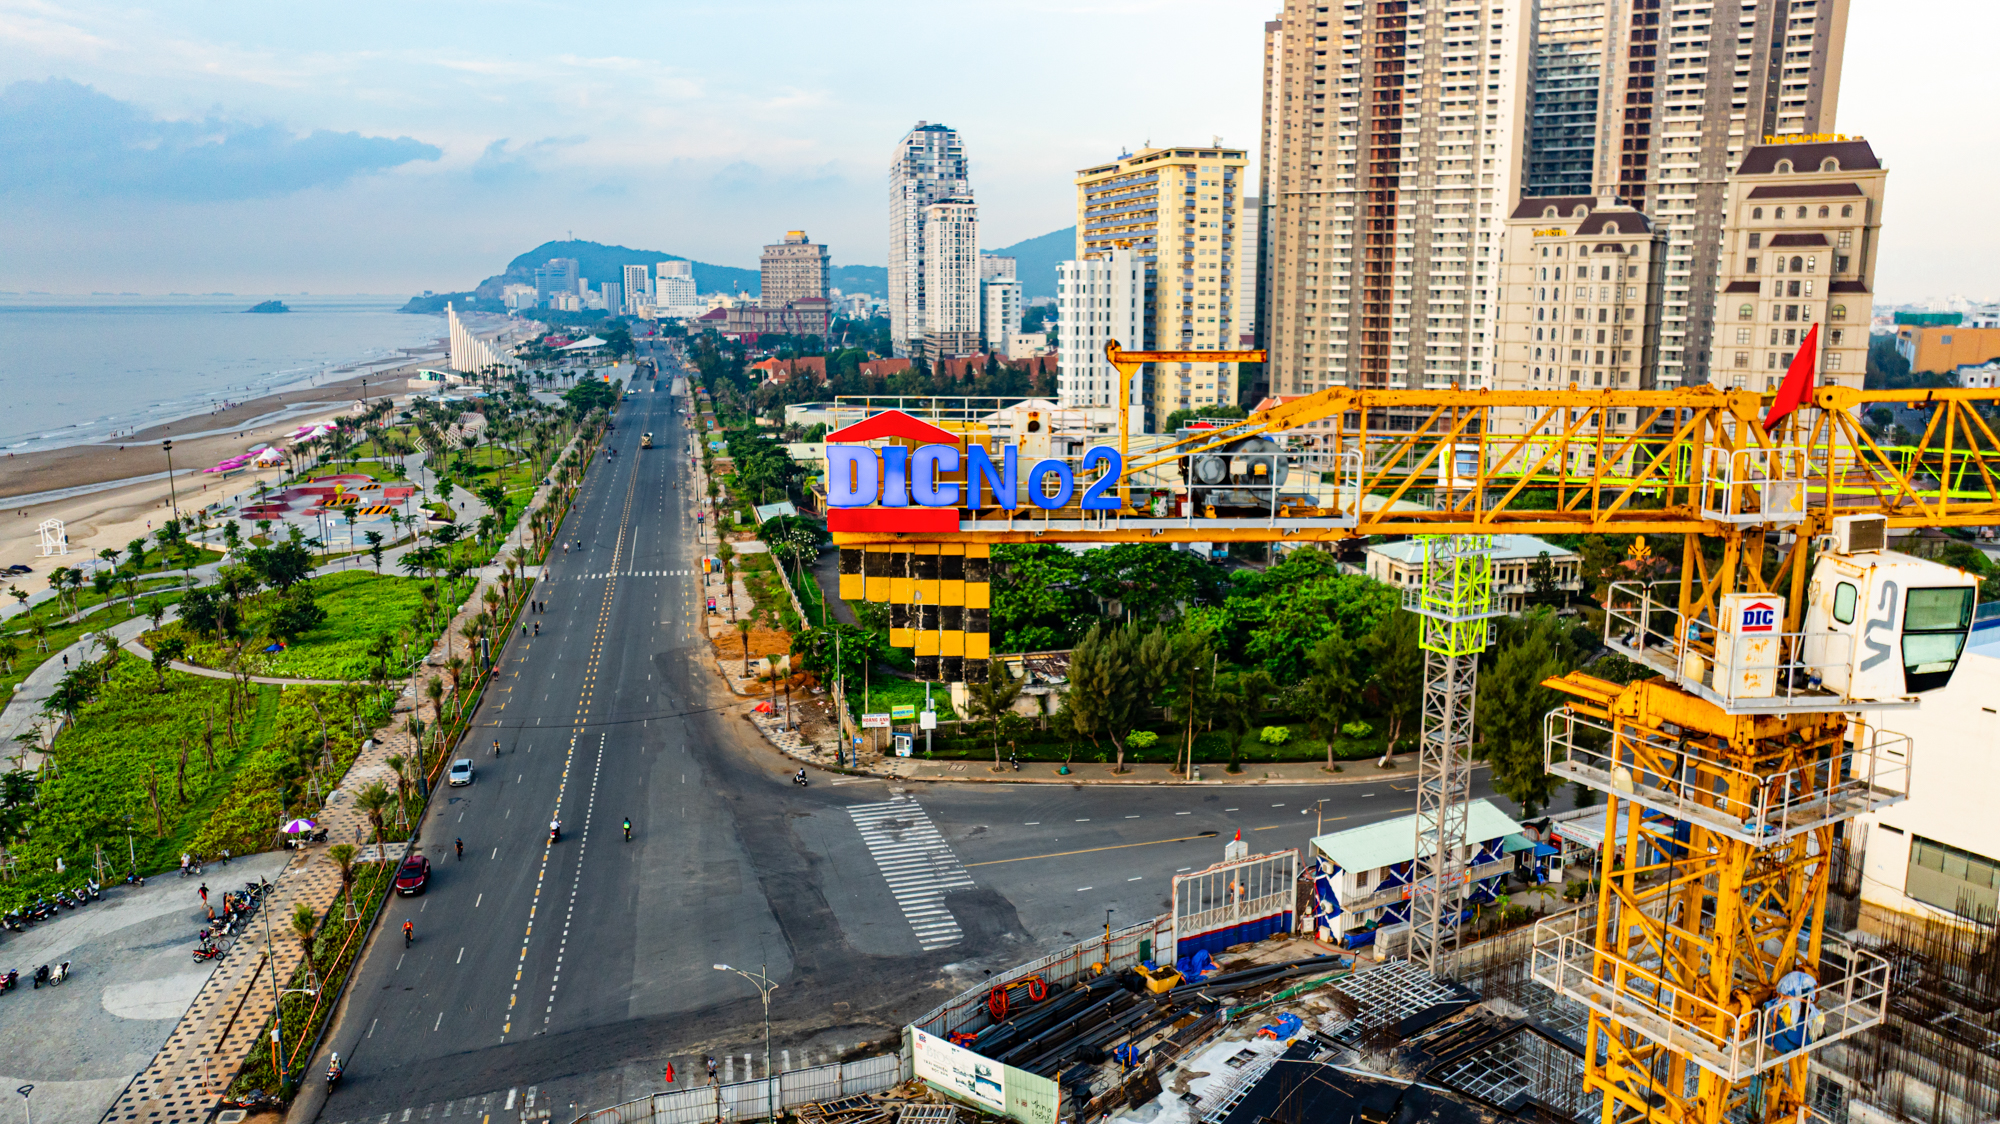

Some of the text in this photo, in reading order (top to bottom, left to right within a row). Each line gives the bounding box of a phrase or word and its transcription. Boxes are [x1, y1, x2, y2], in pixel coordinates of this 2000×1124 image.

[1763, 134, 1786, 145] THE
[1812, 132, 1850, 143] HOTEL
[827, 444, 960, 508] DIC
[1742, 610, 1774, 626] DIC
